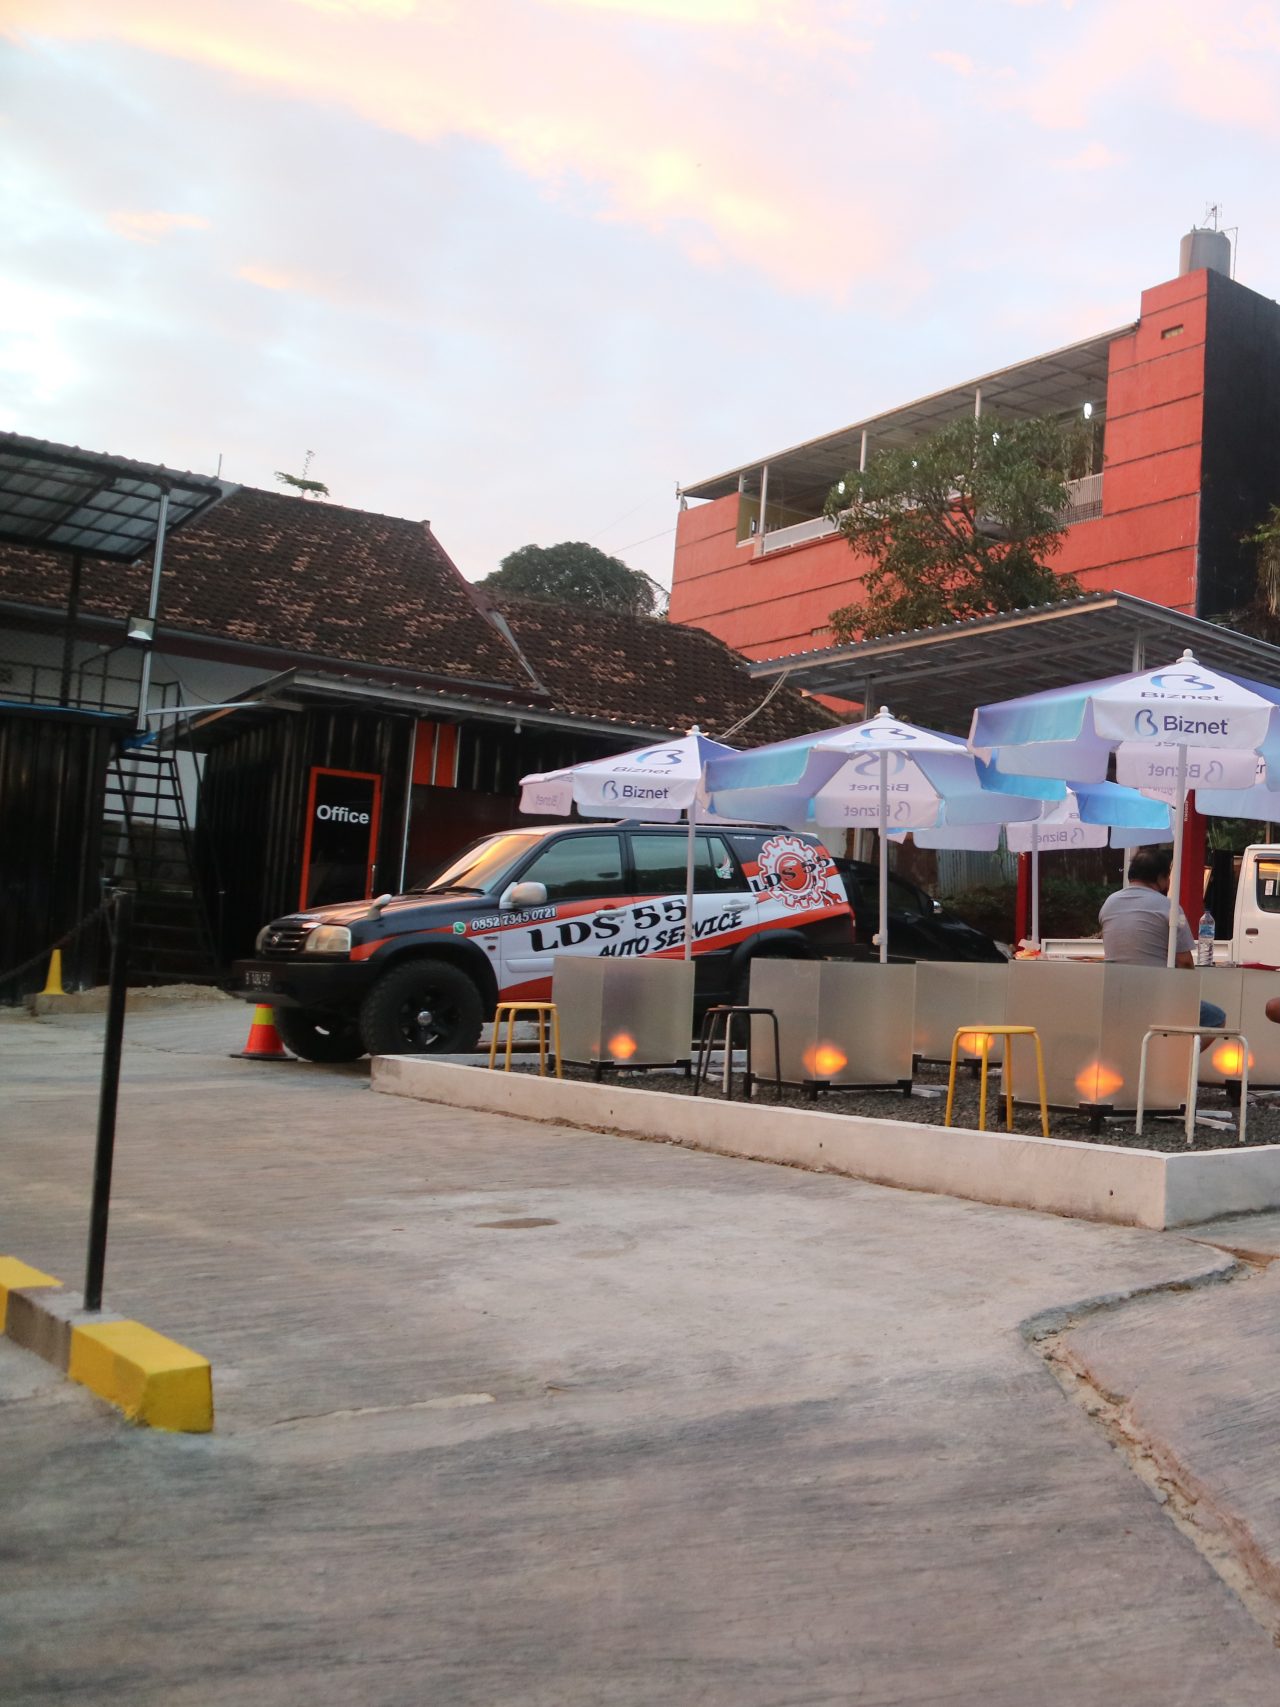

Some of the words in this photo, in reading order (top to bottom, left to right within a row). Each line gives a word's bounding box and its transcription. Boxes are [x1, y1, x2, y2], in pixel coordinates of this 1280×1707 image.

[1141, 691, 1225, 701] Biznet
[1163, 715, 1229, 735] Biznet
[622, 785, 669, 799] Biznet
[316, 804, 370, 824] Office
[471, 914, 501, 932] 0852
[502, 911, 530, 927] 7345
[531, 906, 557, 922] 0721
[527, 917, 621, 952] LDS
[632, 899, 688, 930] 55
[598, 935, 650, 957] AUTO
